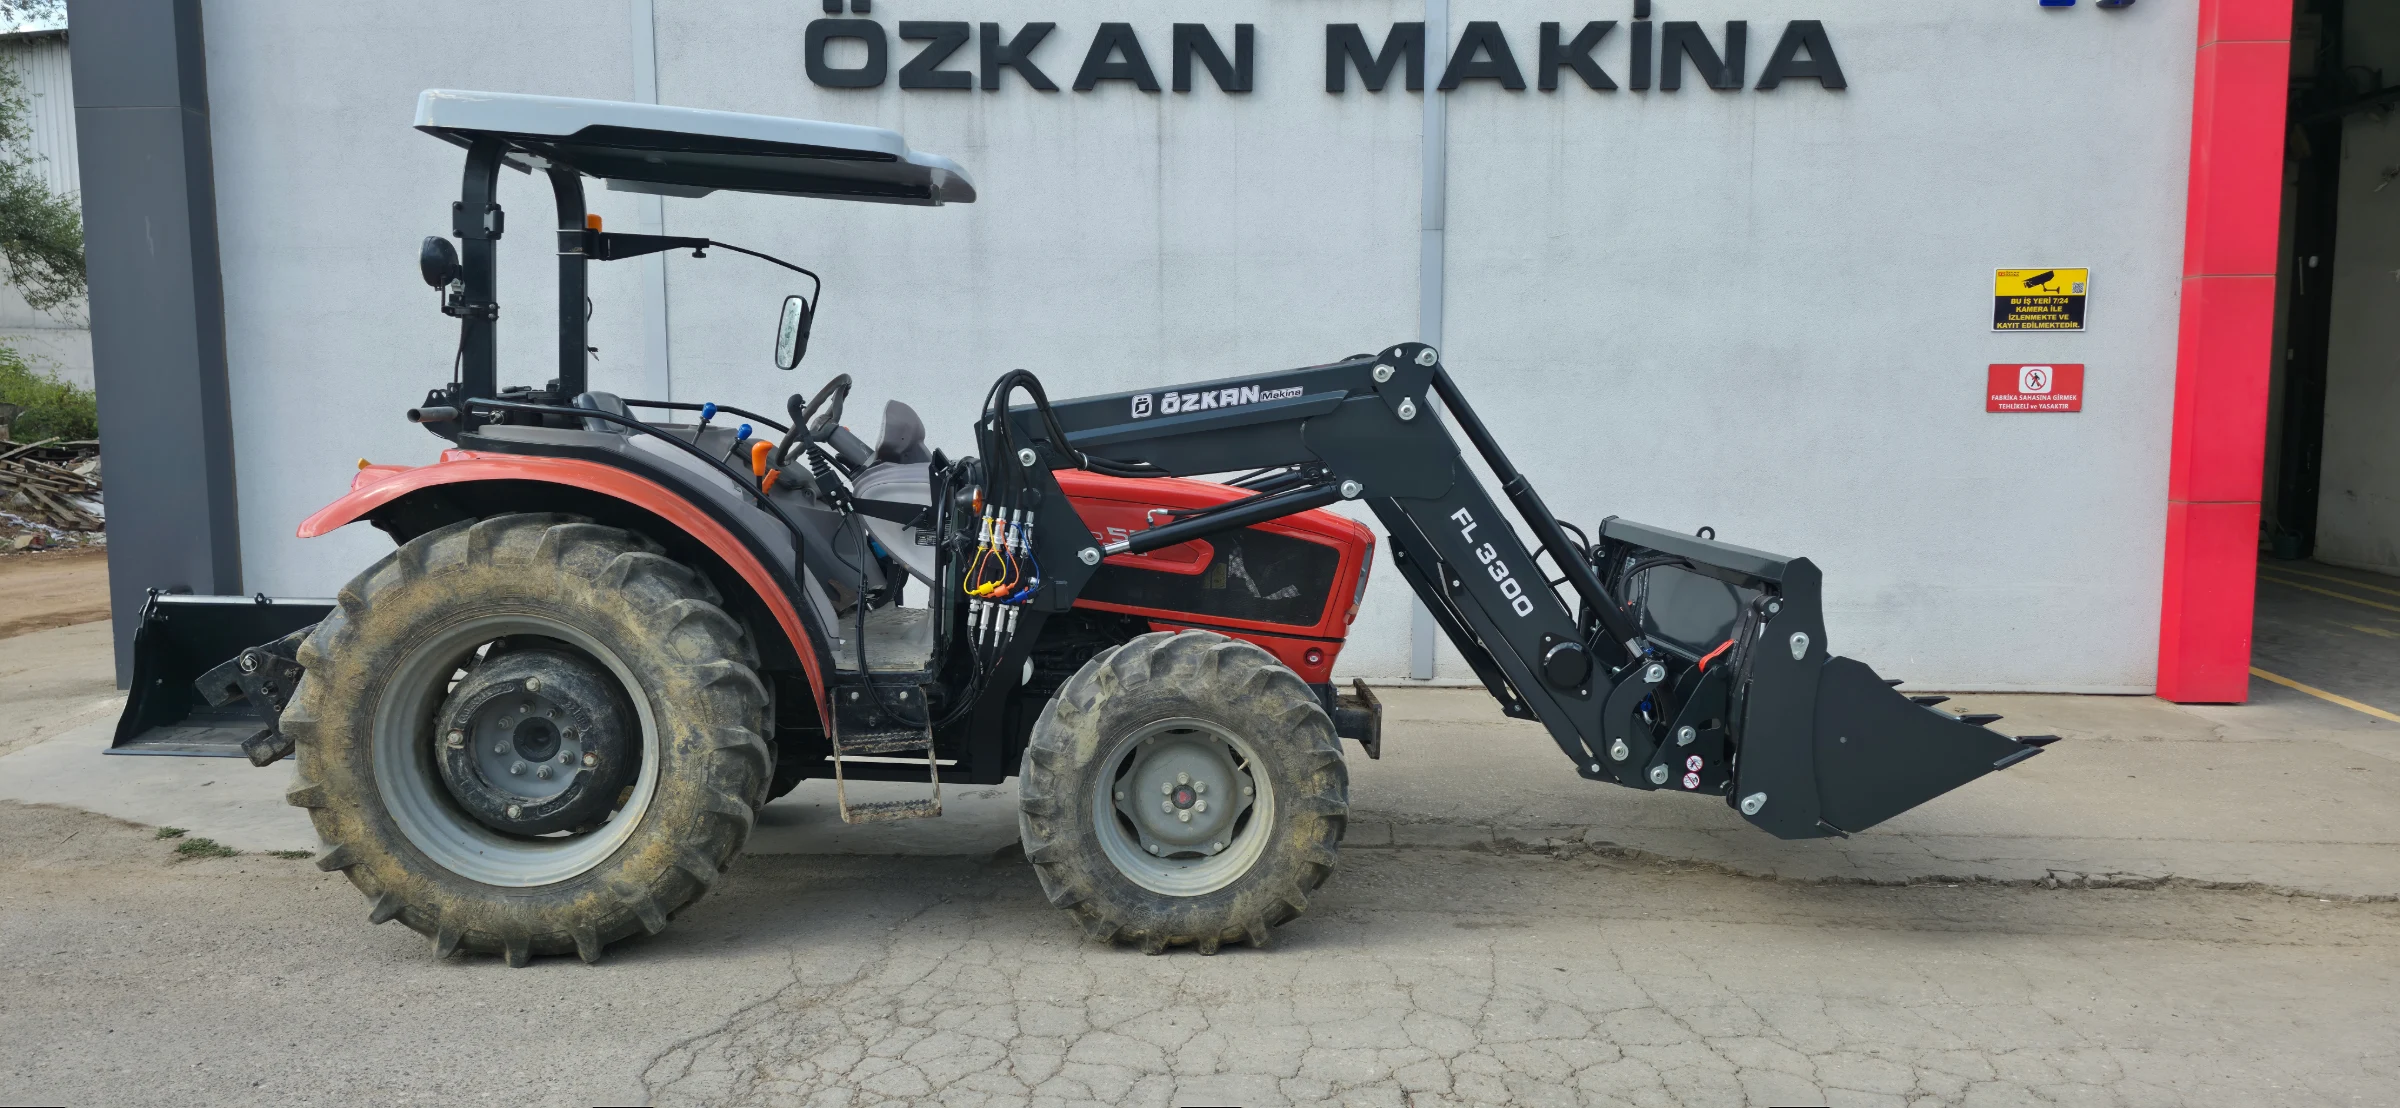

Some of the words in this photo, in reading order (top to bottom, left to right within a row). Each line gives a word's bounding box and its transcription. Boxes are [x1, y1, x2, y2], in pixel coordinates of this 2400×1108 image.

[805, 0, 1254, 95] ÖZKAN
[1326, 0, 1847, 95] MAKİNA
[2024, 297, 2031, 305] İŞ
[1161, 385, 1260, 414] ÖZKAN
[1261, 389, 1301, 400] Makina
[1451, 507, 1477, 544] FL
[1476, 543, 1534, 617] 3300
